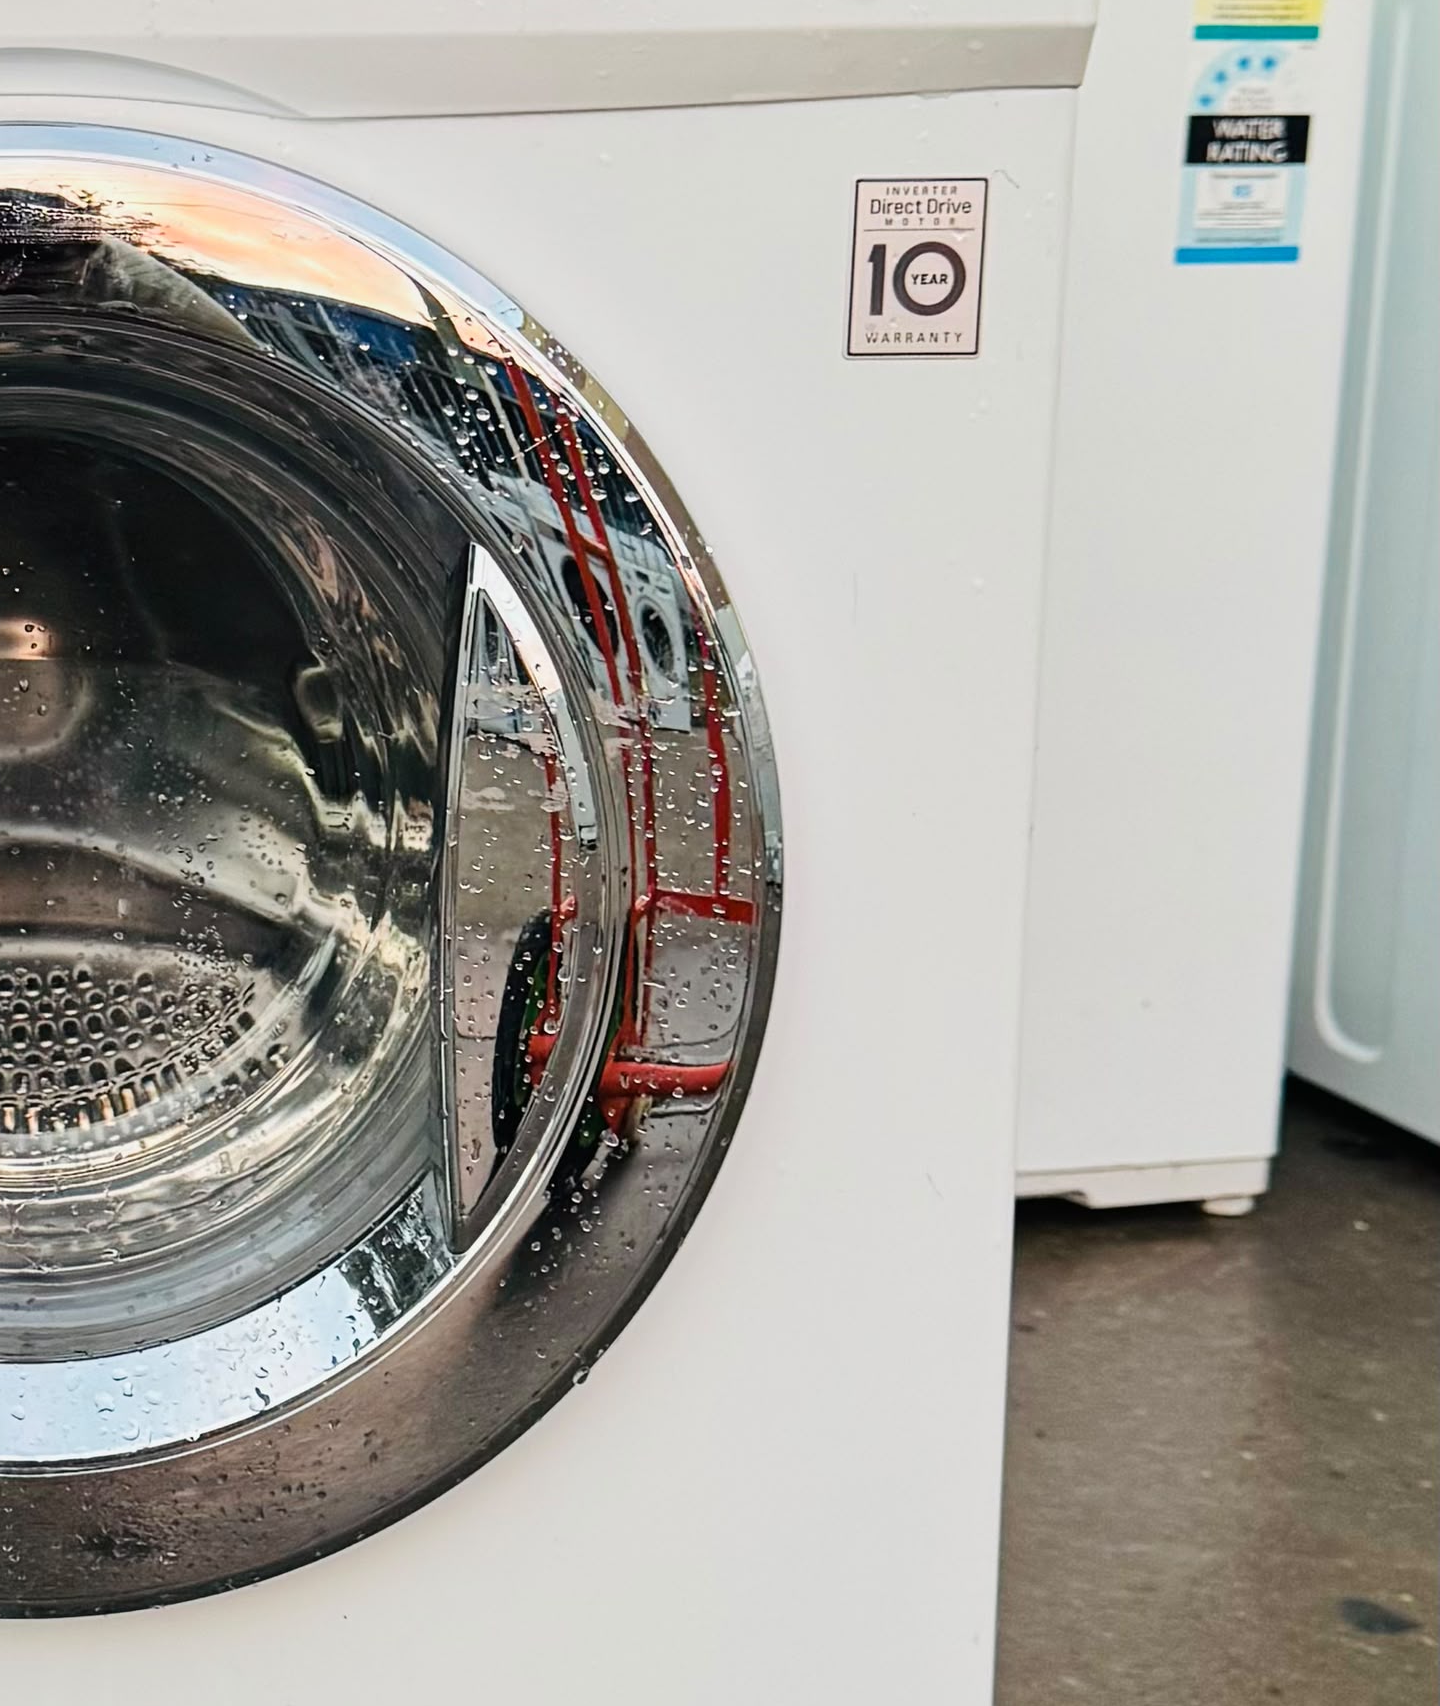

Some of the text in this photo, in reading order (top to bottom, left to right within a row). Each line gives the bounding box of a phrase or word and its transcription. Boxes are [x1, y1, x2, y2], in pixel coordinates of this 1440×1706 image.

[1212, 117, 1287, 140] WATER
[1206, 141, 1289, 163] RATING
[885, 185, 958, 196] INVERTER
[870, 198, 972, 215] Direct Drive
[885, 217, 956, 227] MOTOR
[867, 241, 967, 316] 10
[911, 273, 949, 286] YEAR
[865, 331, 963, 344] WARRANTY
